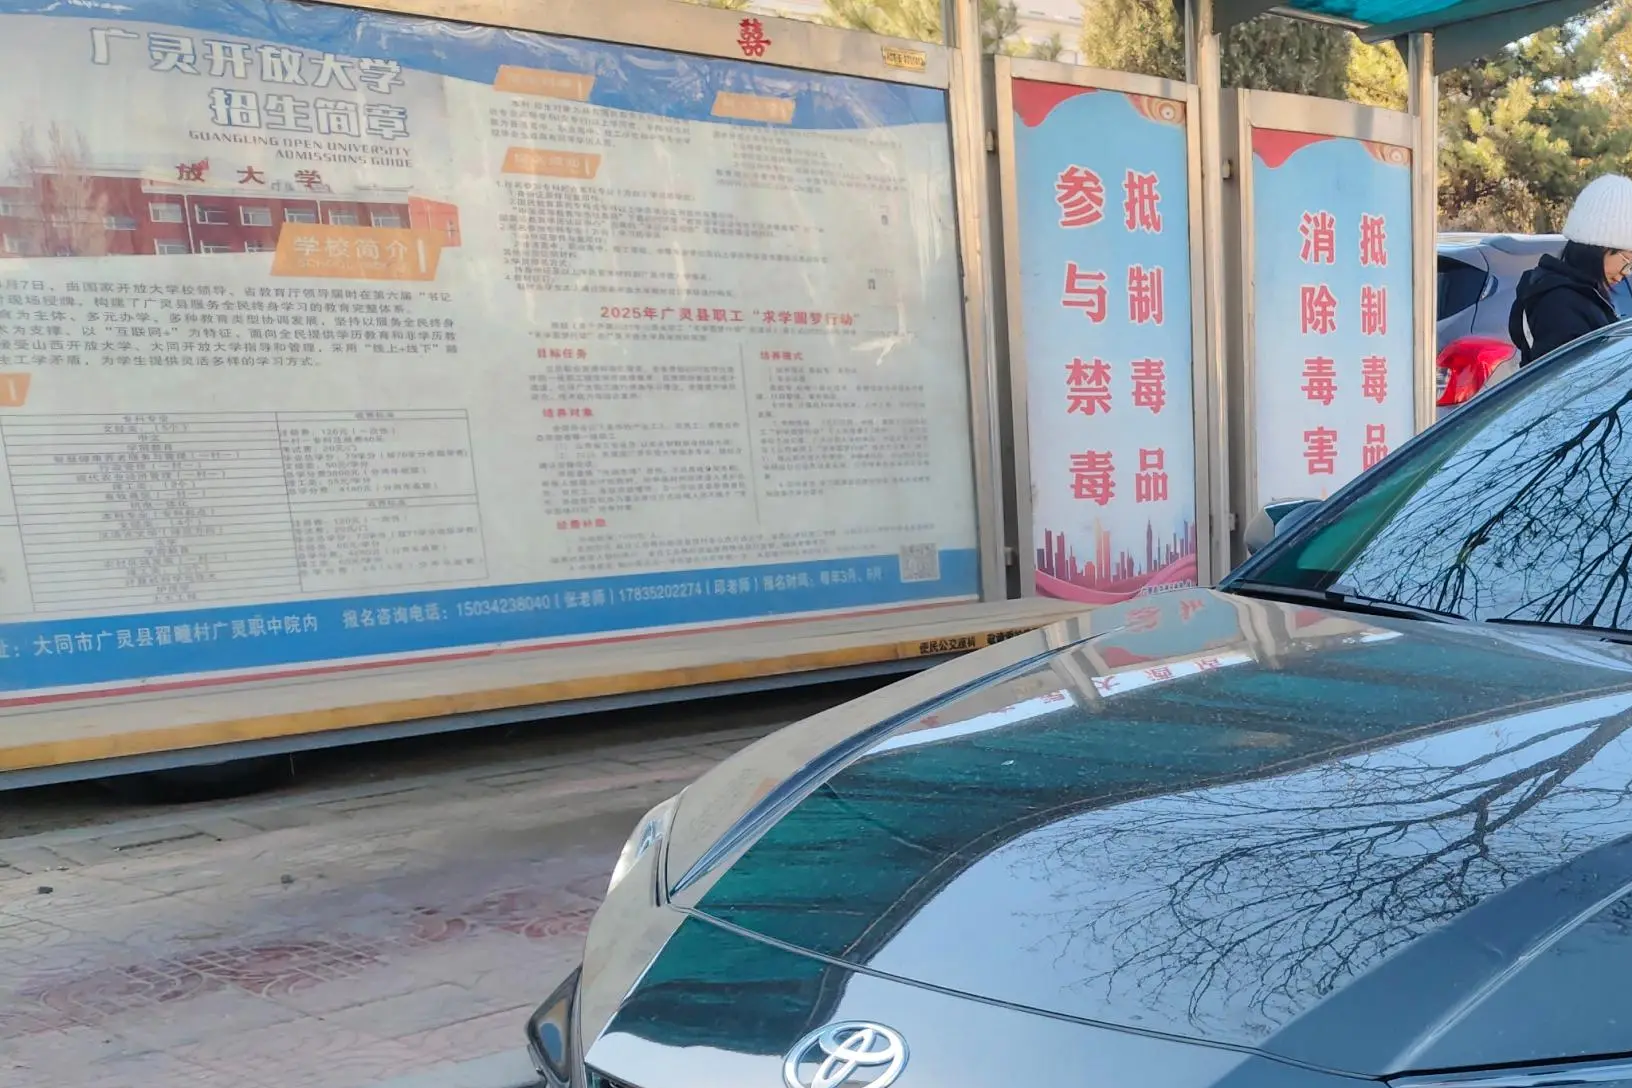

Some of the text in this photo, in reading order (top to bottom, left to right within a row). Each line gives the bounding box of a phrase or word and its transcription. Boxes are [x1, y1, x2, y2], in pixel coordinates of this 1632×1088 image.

[90, 27, 404, 95] 广灵开放大学
[189, 130, 412, 157] GUANGLING OPEN UNIVERSITY
[209, 87, 410, 140] 招生简章
[275, 149, 413, 169] ADMISSIONS GUIDE
[294, 236, 408, 261] 学校简介
[1055, 164, 1116, 505] 参与禁毒
[1123, 169, 1169, 503] 抵制毒品
[1299, 210, 1339, 476] 消除毒害
[1359, 213, 1389, 472] 抵制毒品
